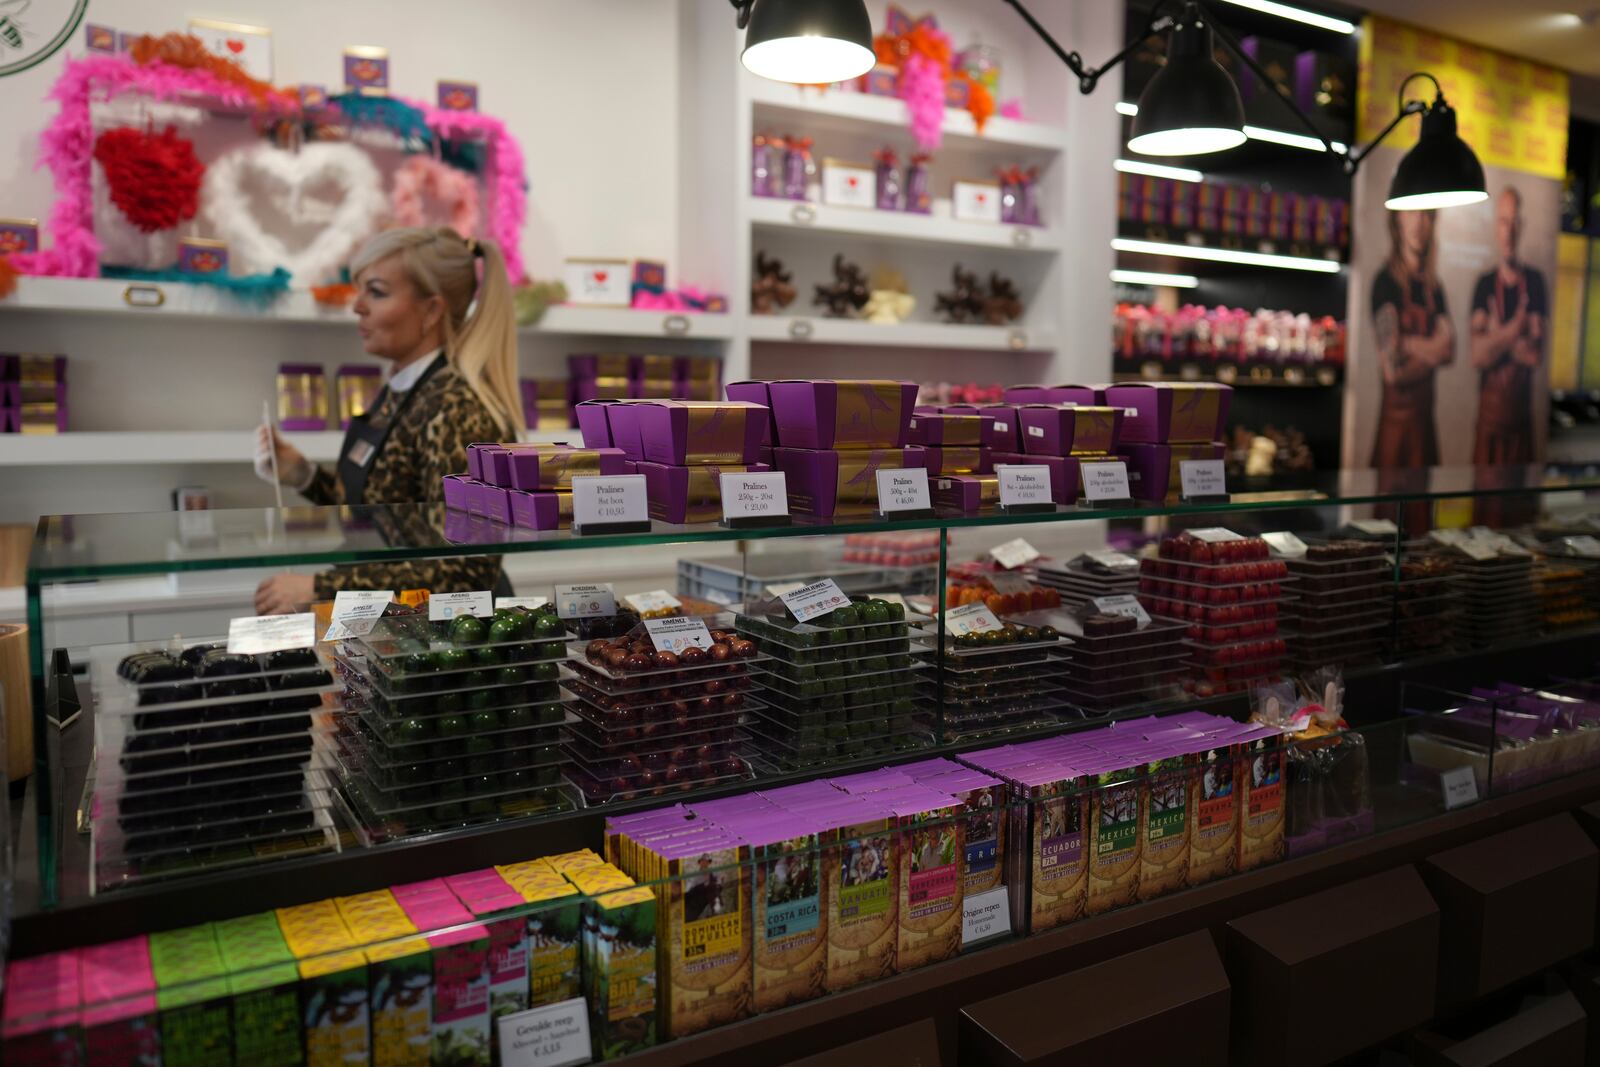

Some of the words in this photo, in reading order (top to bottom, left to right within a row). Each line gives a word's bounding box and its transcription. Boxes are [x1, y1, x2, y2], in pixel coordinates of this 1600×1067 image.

[893, 478, 913, 486] Pralines
[1015, 474, 1036, 482] Pralines
[596, 485, 625, 494] Pralines
[743, 482, 768, 490] Pralines
[610, 496, 624, 505] box
[738, 493, 754, 502] 250g
[751, 502, 768, 511] 23,00
[1150, 812, 1184, 828] MEXICO
[1099, 826, 1136, 842] MEXICO
[967, 847, 996, 862] ERU
[1042, 839, 1081, 856] ECUADOR
[768, 910, 796, 925] COSTA
[798, 903, 817, 918] RICA
[685, 918, 740, 937] DOMINICAN
[685, 926, 740, 946] REPUBLIC
[516, 1020, 552, 1037] Gevulde
